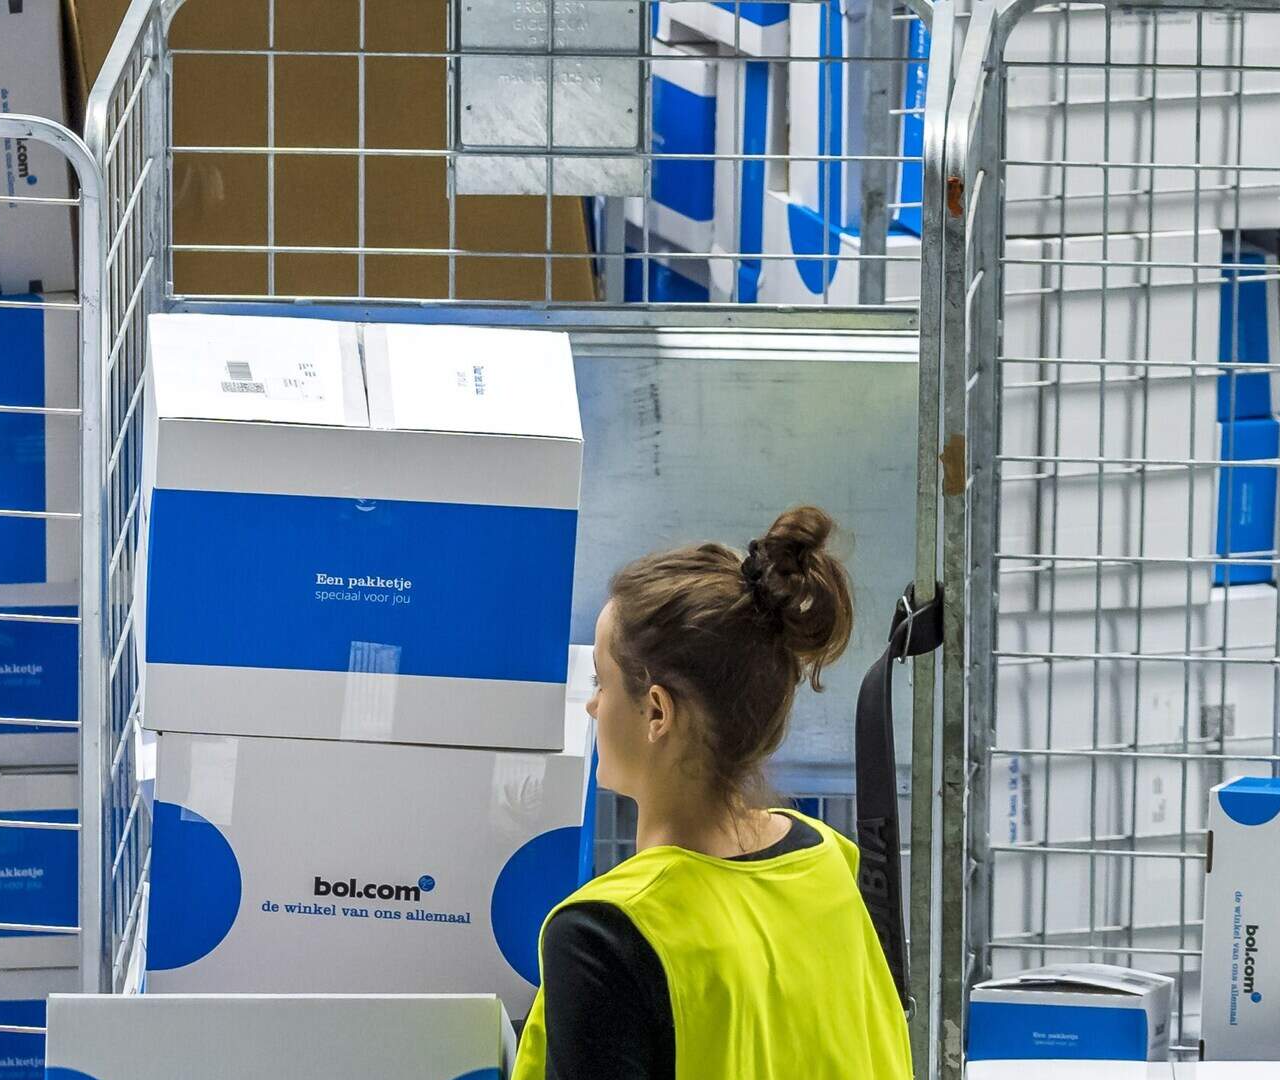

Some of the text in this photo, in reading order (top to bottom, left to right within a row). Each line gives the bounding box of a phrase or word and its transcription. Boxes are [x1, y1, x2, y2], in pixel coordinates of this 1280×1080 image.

[315, 573, 412, 592] Een pakketje
[315, 590, 411, 606] speciaal voor jou
[313, 876, 421, 902] bol.com
[261, 901, 472, 925] de winkel van ons allemaal
[1229, 890, 1243, 1026] de winkel van ons allemaal
[1243, 924, 1260, 993] bol.com
